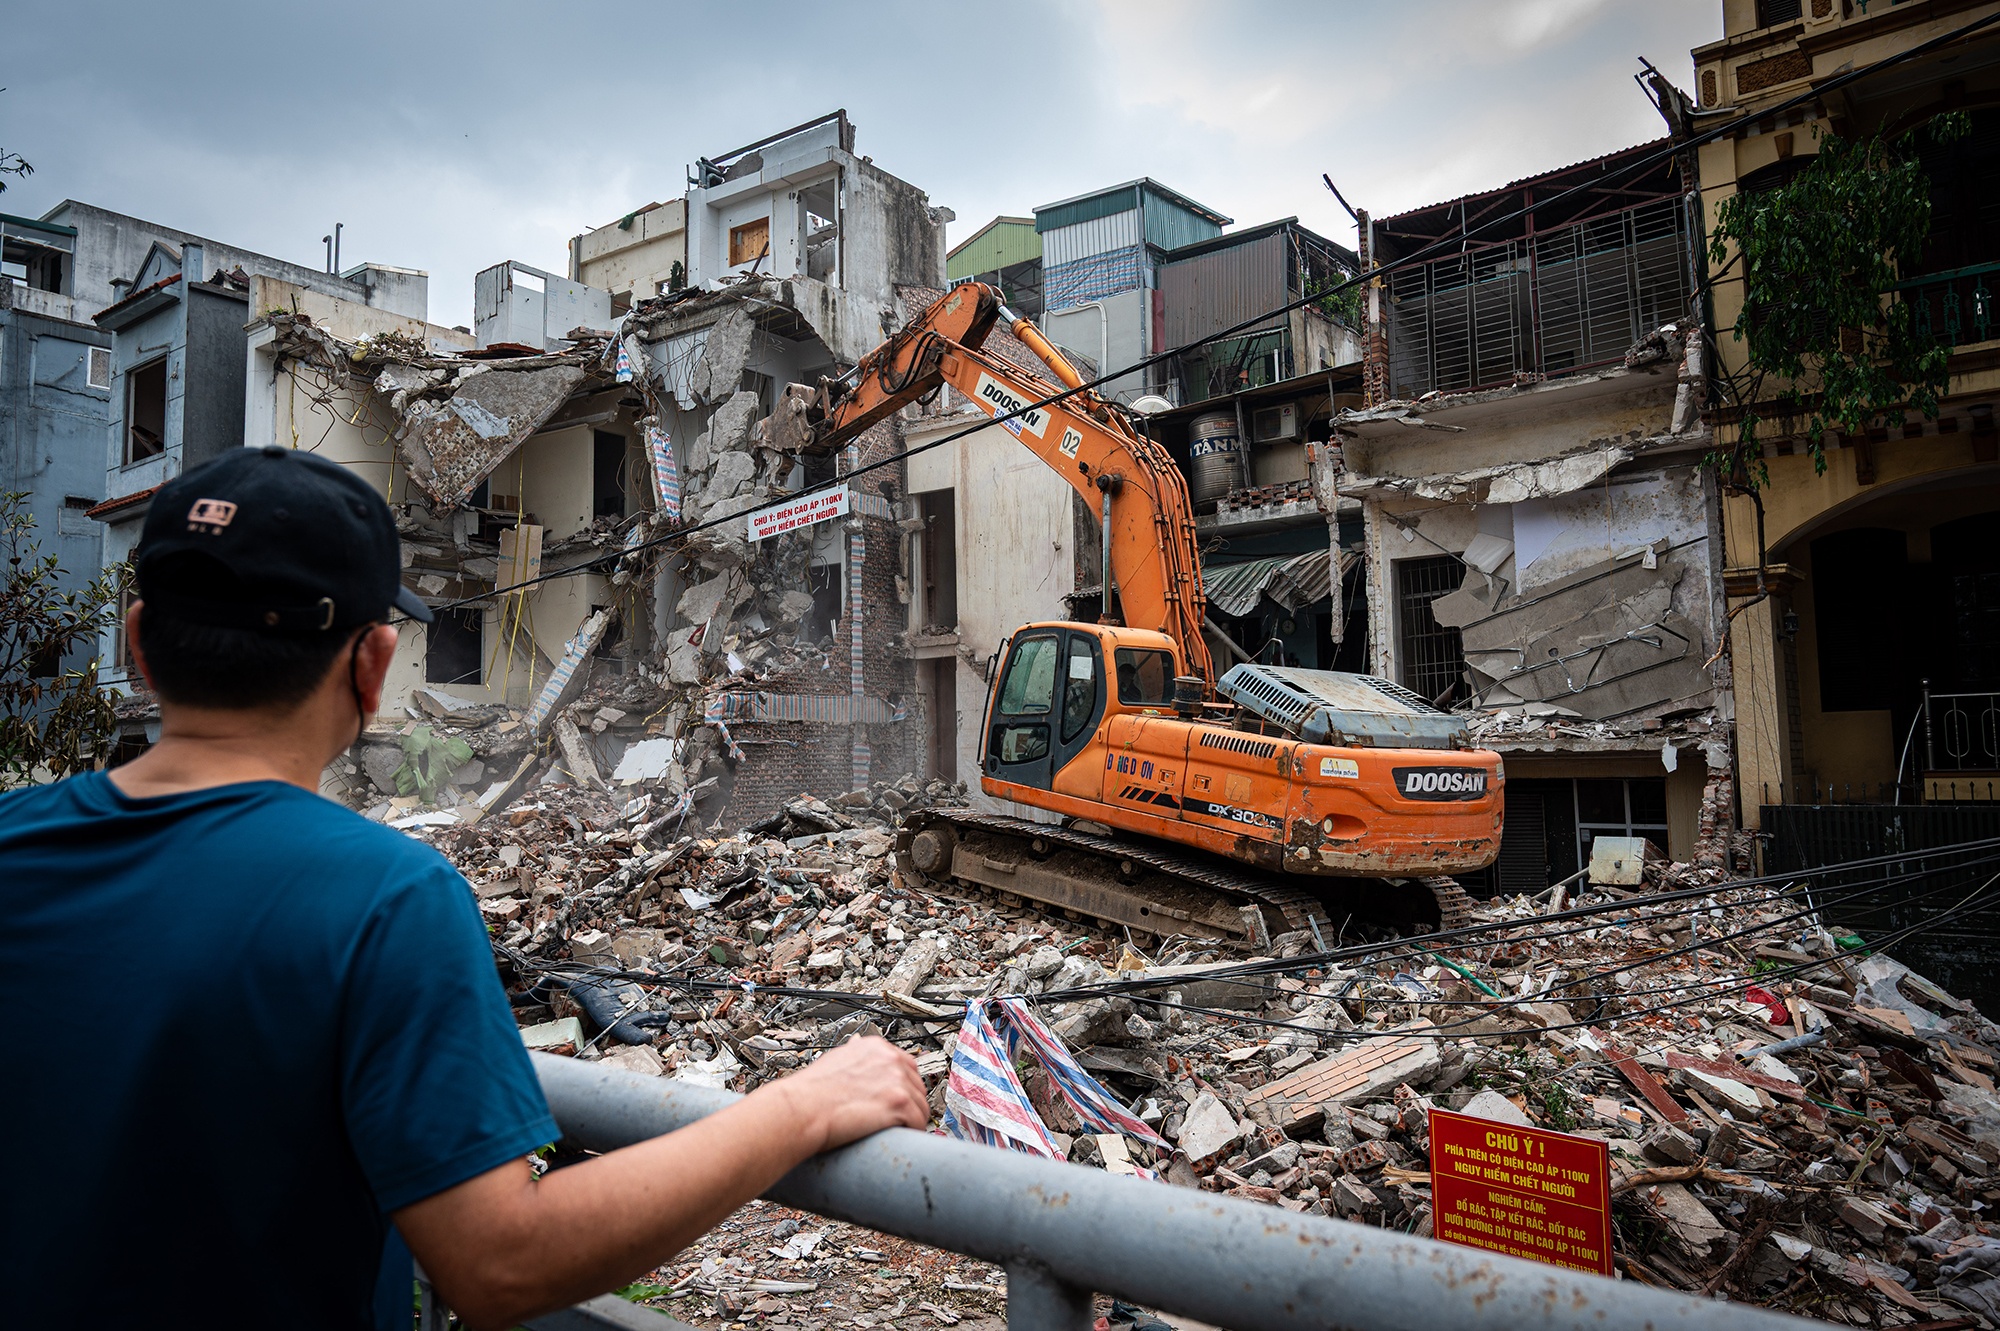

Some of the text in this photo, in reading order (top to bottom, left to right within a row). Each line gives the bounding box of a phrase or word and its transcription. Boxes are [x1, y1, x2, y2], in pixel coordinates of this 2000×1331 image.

[1062, 431, 1080, 455] 02
[754, 514, 768, 527] CHÚ
[777, 508, 793, 520] ĐIỆN
[794, 503, 808, 515] CAO
[810, 499, 819, 510] ÁP
[821, 493, 843, 507] 110KV
[759, 525, 777, 537] NGUY
[797, 512, 814, 526] CHẾT
[816, 505, 838, 520] NGƯỜI
[1405, 772, 1484, 793] DOOSAN
[1486, 1131, 1545, 1158] CHÚ Ý !
[1445, 1143, 1590, 1184] PHÍA TRÊN CÓ ĐIỆN CAO ÁP 110KV
[1454, 1161, 1576, 1198] NGUY HIỂM CHẾT NGƯỜI
[1456, 1197, 1586, 1241] ĐỔ RÁC, TẬP KẾT RÁC, ĐỐT RÁC
[1488, 1191, 1547, 1215] NGHIÊM CẤM:
[1444, 1212, 1599, 1261] DƯỚI ĐƯỜNG DÂY ĐIỆN CAO ÁP 110KV
[1509, 1247, 1521, 1256] 024
